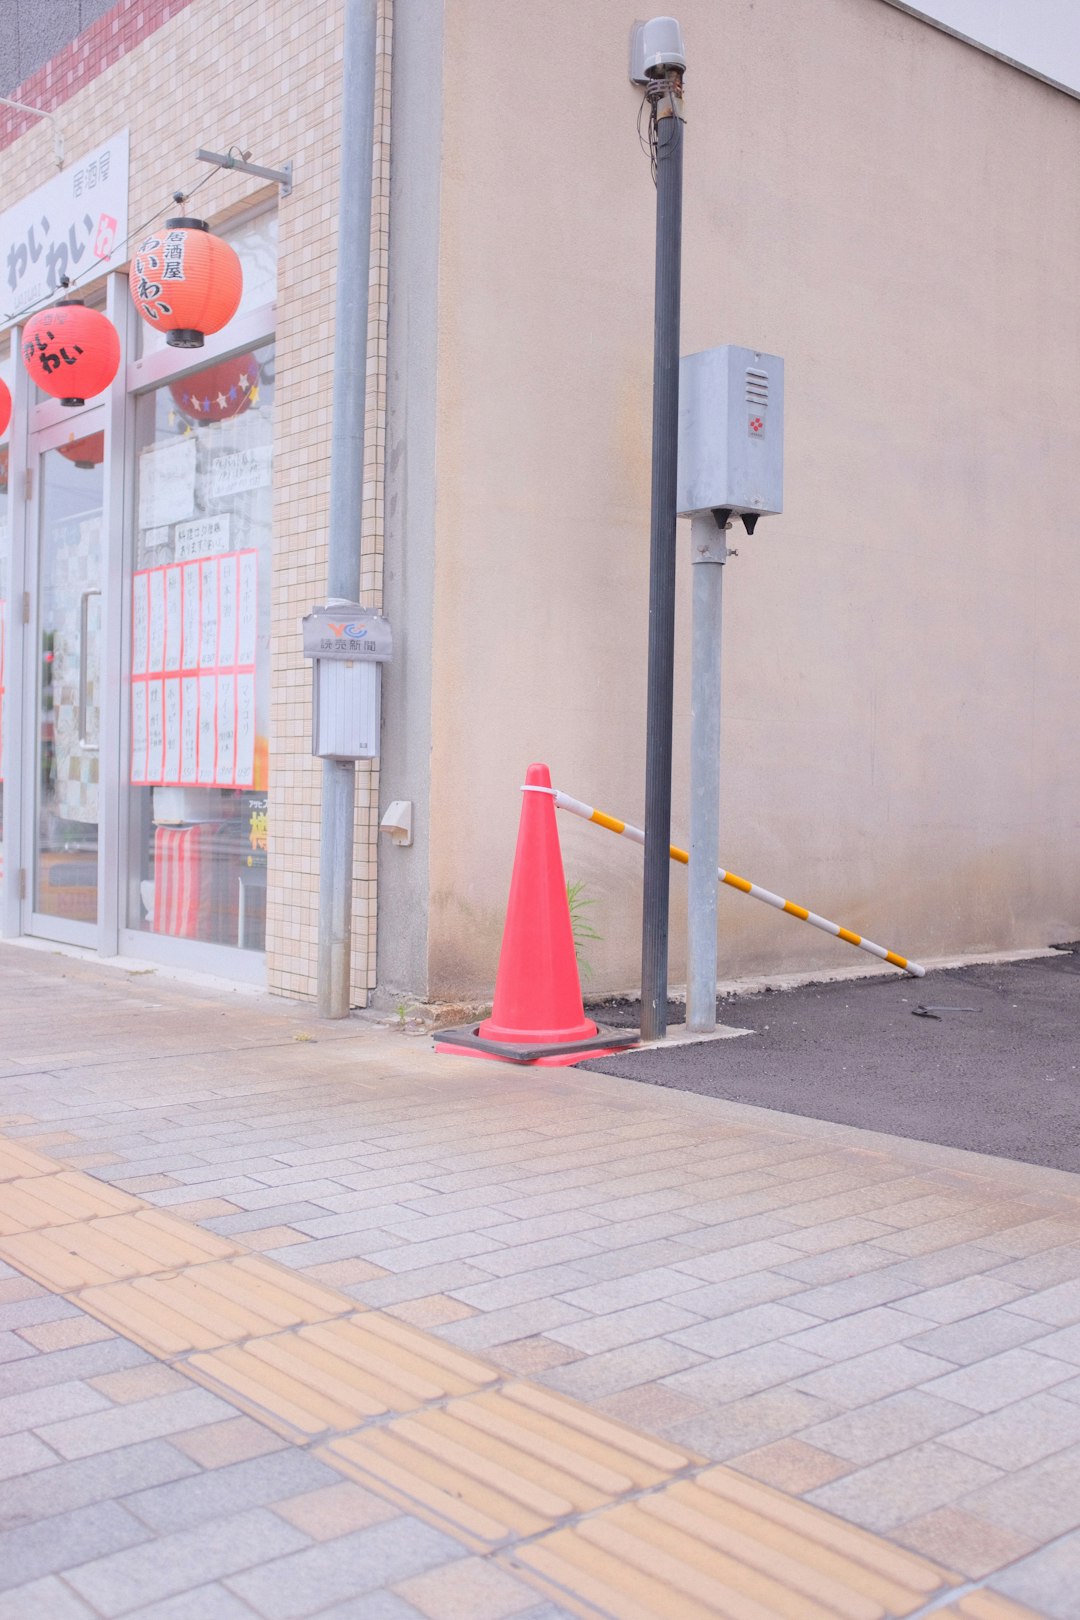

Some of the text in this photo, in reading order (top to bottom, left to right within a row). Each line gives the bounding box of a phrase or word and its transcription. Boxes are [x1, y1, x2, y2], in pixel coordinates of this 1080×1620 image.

[73, 150, 111, 199] 居酒屋
[6, 213, 94, 294] わいわい
[137, 236, 171, 319] わいわい
[163, 231, 186, 279] 居酒屋
[23, 330, 84, 374] わいわい
[320, 638, 376, 651] 読売新聞
